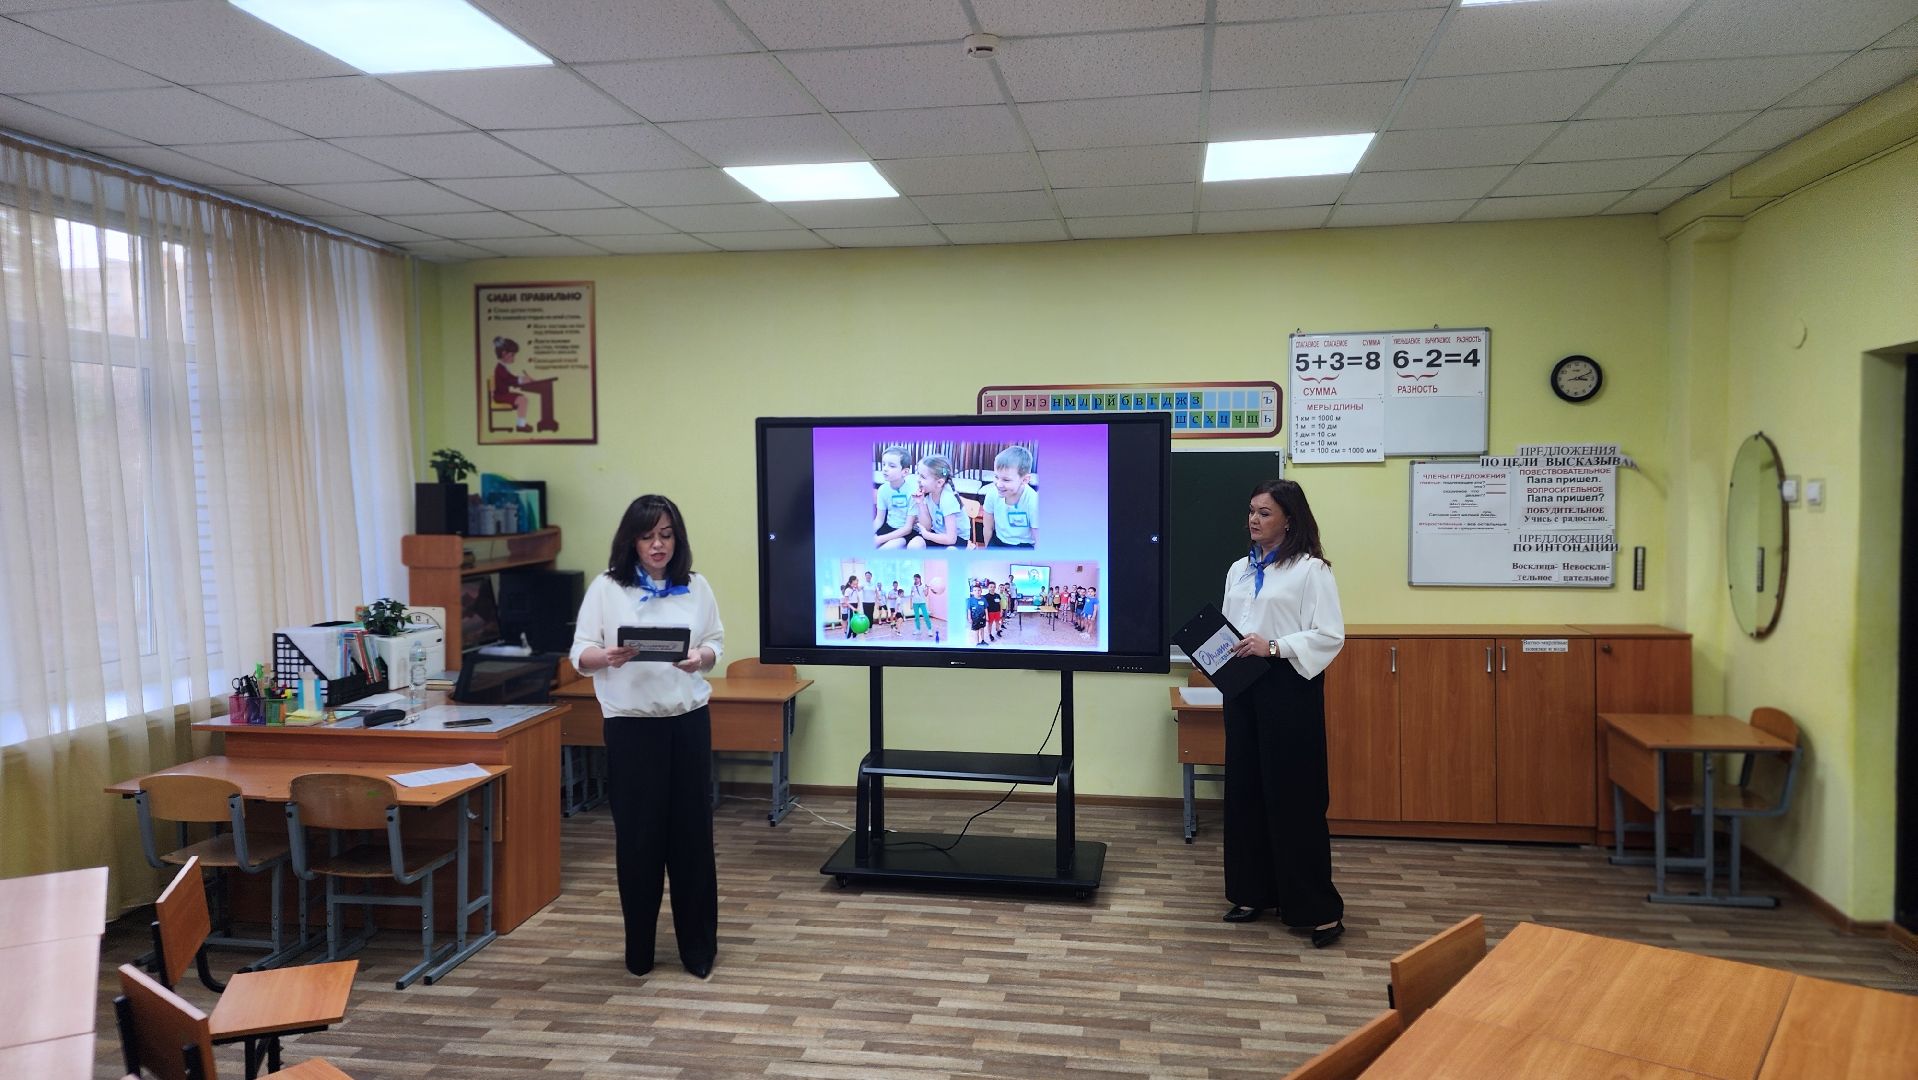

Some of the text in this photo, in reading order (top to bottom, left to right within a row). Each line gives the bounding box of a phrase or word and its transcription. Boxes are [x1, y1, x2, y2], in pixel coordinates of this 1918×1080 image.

[487, 292, 582, 302] СИДИ ПРАВИЛЬНО
[1303, 387, 1337, 396] СУММА
[1397, 385, 1438, 394] РАЗНОСТЬ
[1521, 446, 1616, 456] ПРЕДЛОЖЕНИЯ
[1480, 458, 1499, 467] ПО
[1503, 457, 1538, 467] ЦЕЛИ
[1556, 476, 1601, 485] пришел.
[1556, 493, 1604, 503] пришел?
[1520, 534, 1613, 543] ПРЕДЛОЖЕНИЯ
[1513, 543, 1618, 552] ПО ИНТОНАЦИИ
